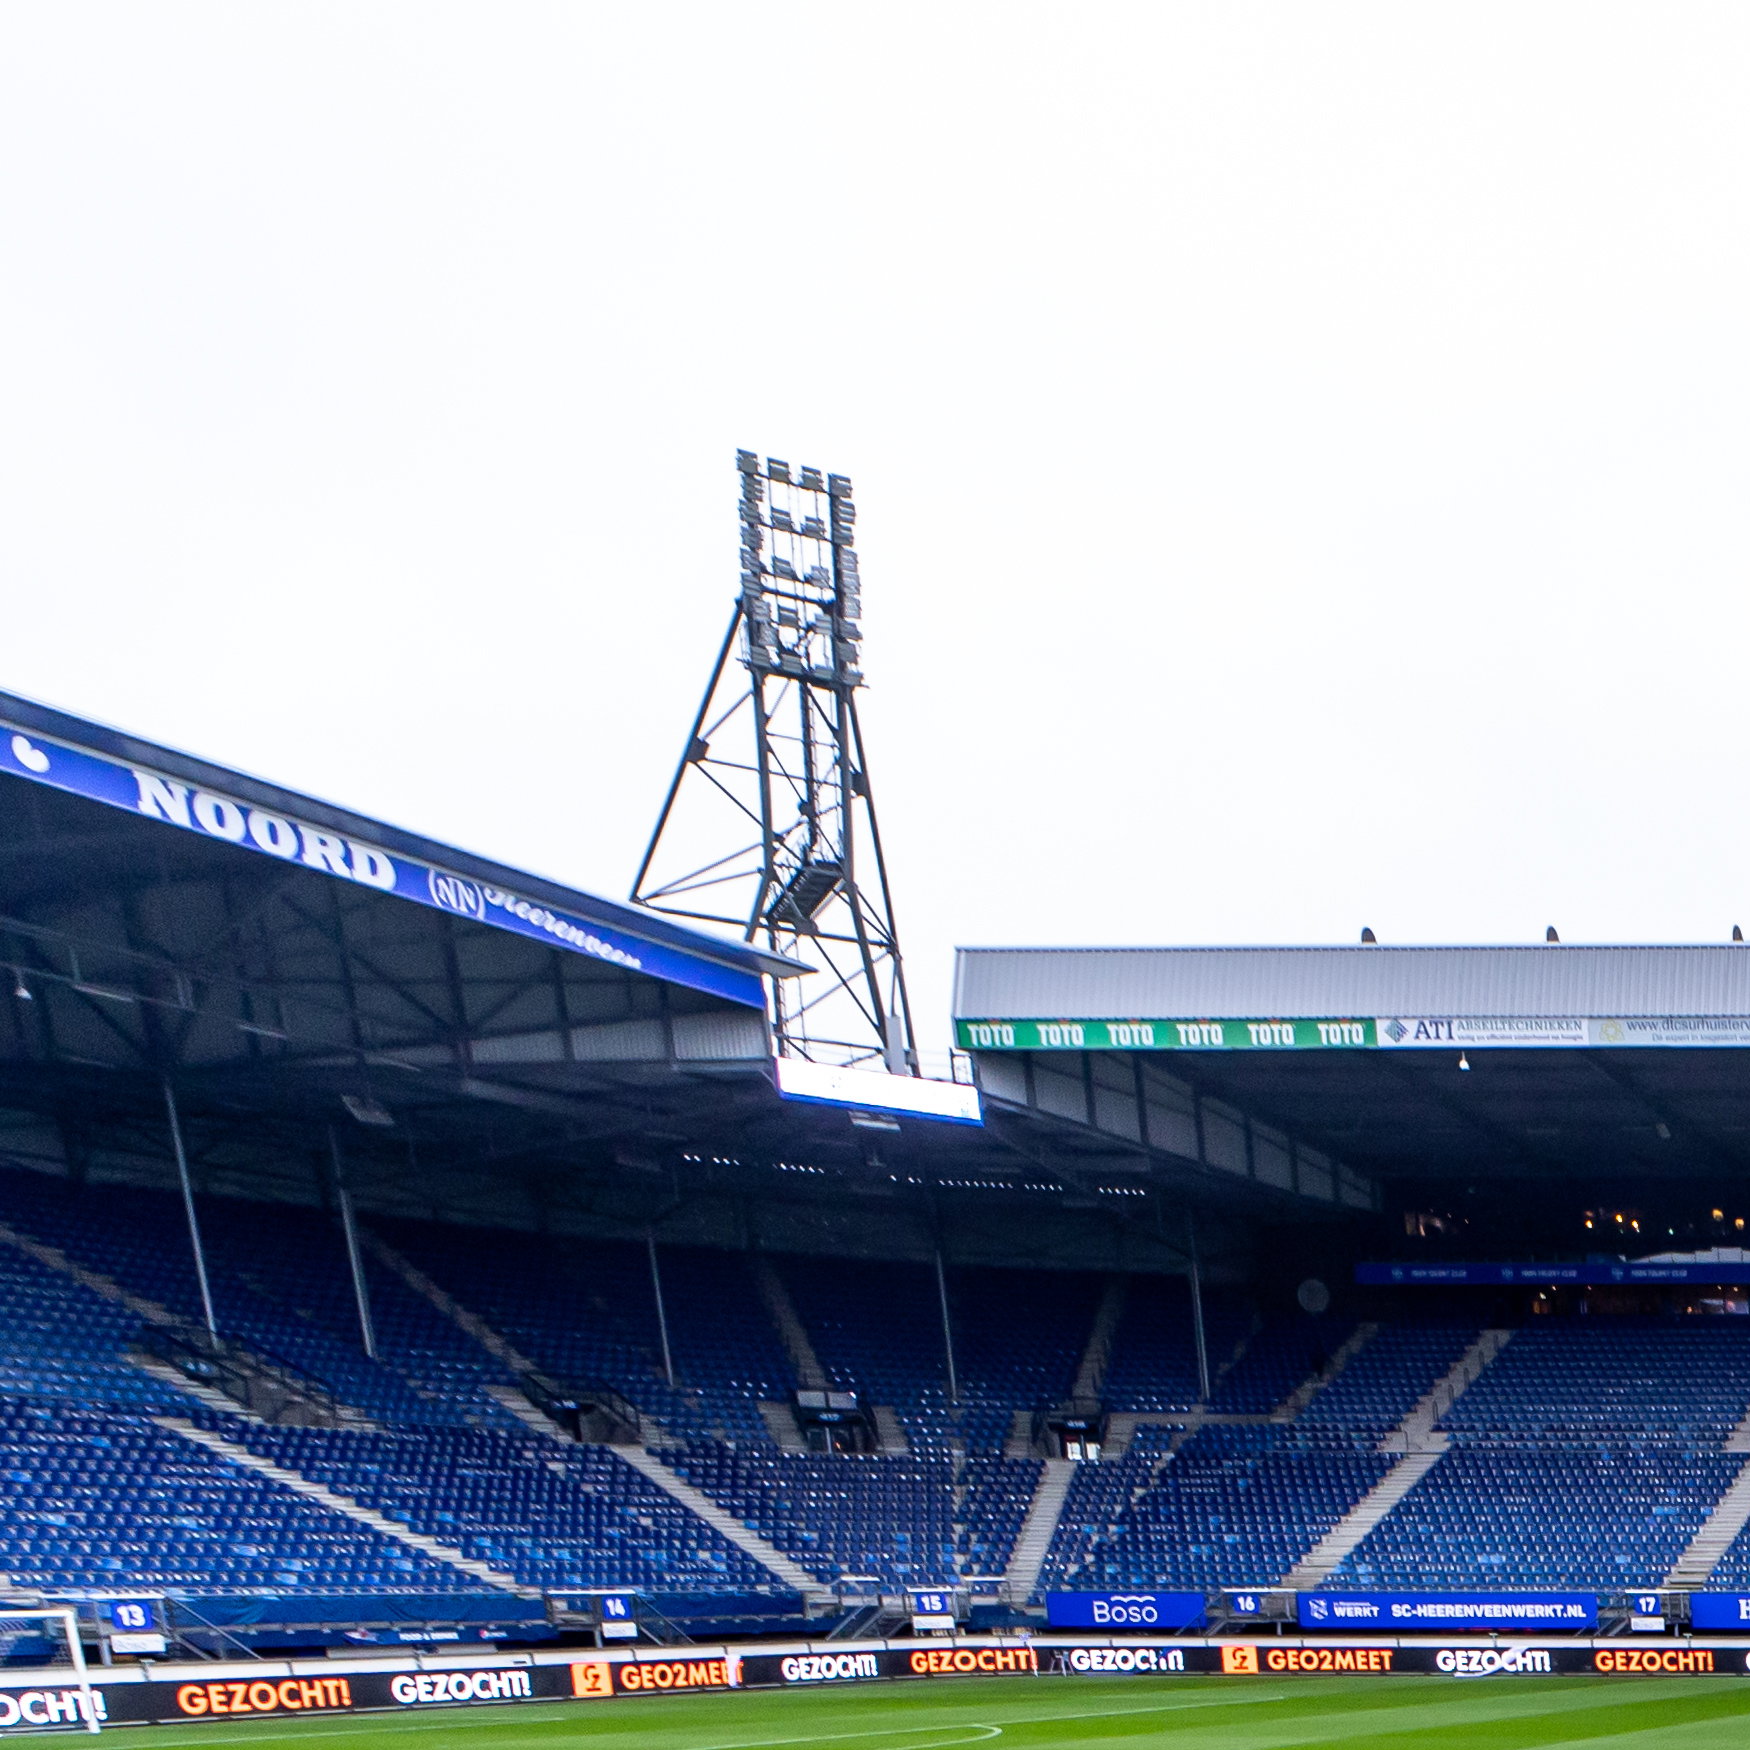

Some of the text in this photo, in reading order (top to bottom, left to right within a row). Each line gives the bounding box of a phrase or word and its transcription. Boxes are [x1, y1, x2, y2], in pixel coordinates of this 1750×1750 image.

[132, 770, 398, 892] NOORD
[967, 1022, 1365, 1048] TOTO TOTO TOTO TOTO TOTO TOTO
[1413, 1019, 1458, 1042] ATI
[605, 1598, 626, 1616] 14
[920, 1594, 943, 1611] 15
[1092, 1600, 1158, 1623] Boso
[1237, 1595, 1256, 1611] 16
[1333, 1604, 1380, 1618] WERKT
[1390, 1603, 1587, 1618] SC-HEERENVEENWERKT.NL
[1638, 1596, 1656, 1613] 17
[116, 1604, 146, 1625] 13
[781, 1653, 878, 1681] GEZOCHT!
[911, 1650, 1037, 1673] GEZOCHT!
[1266, 1649, 1394, 1671] GEO2MEET
[1435, 1649, 1552, 1674] GEZOCHT!
[1594, 1649, 1714, 1672] GEZOCHT!
[177, 1679, 353, 1715] GEZOCHT!
[391, 1670, 533, 1704] GEZOCHT!
